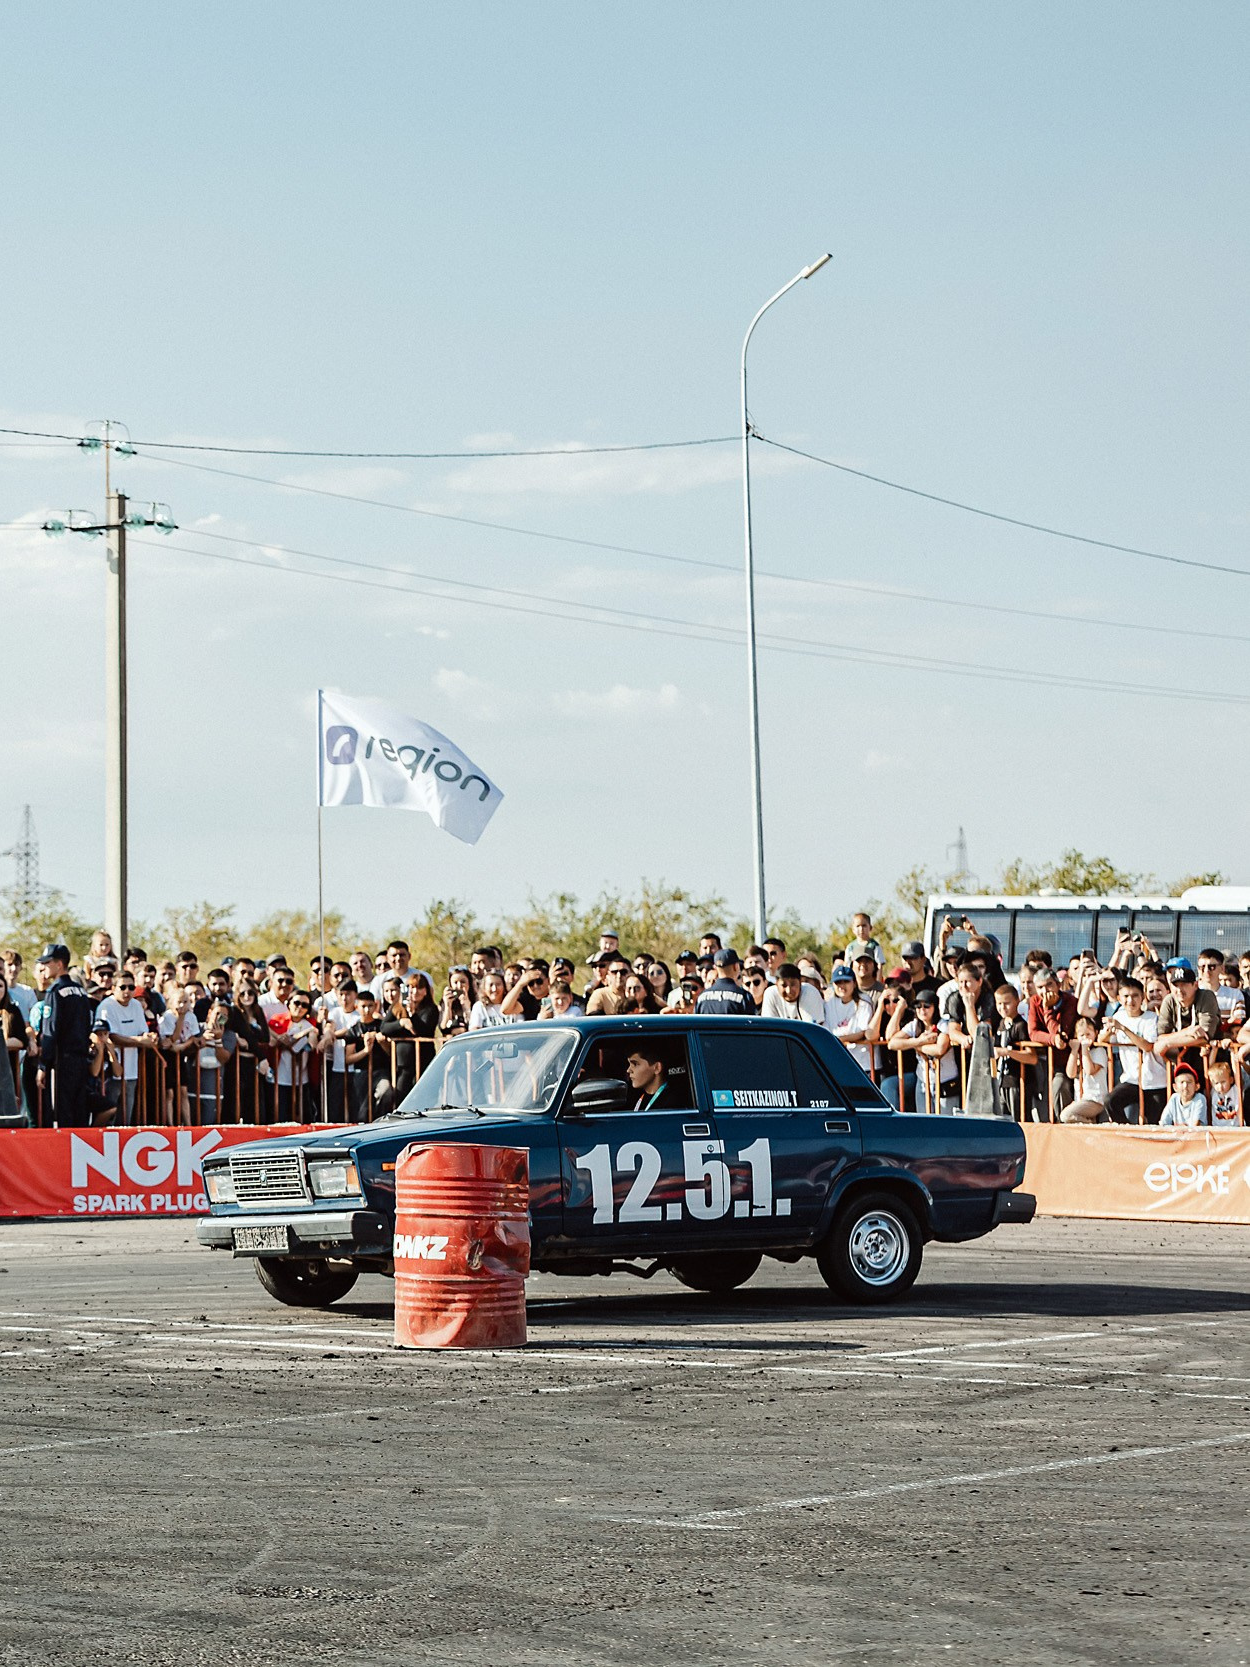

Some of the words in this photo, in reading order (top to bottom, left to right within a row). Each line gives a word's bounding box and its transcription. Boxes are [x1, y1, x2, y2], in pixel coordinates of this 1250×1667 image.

[810, 1100, 829, 1108] 2107
[71, 1129, 223, 1188] NGK
[73, 1194, 146, 1213] SPARK
